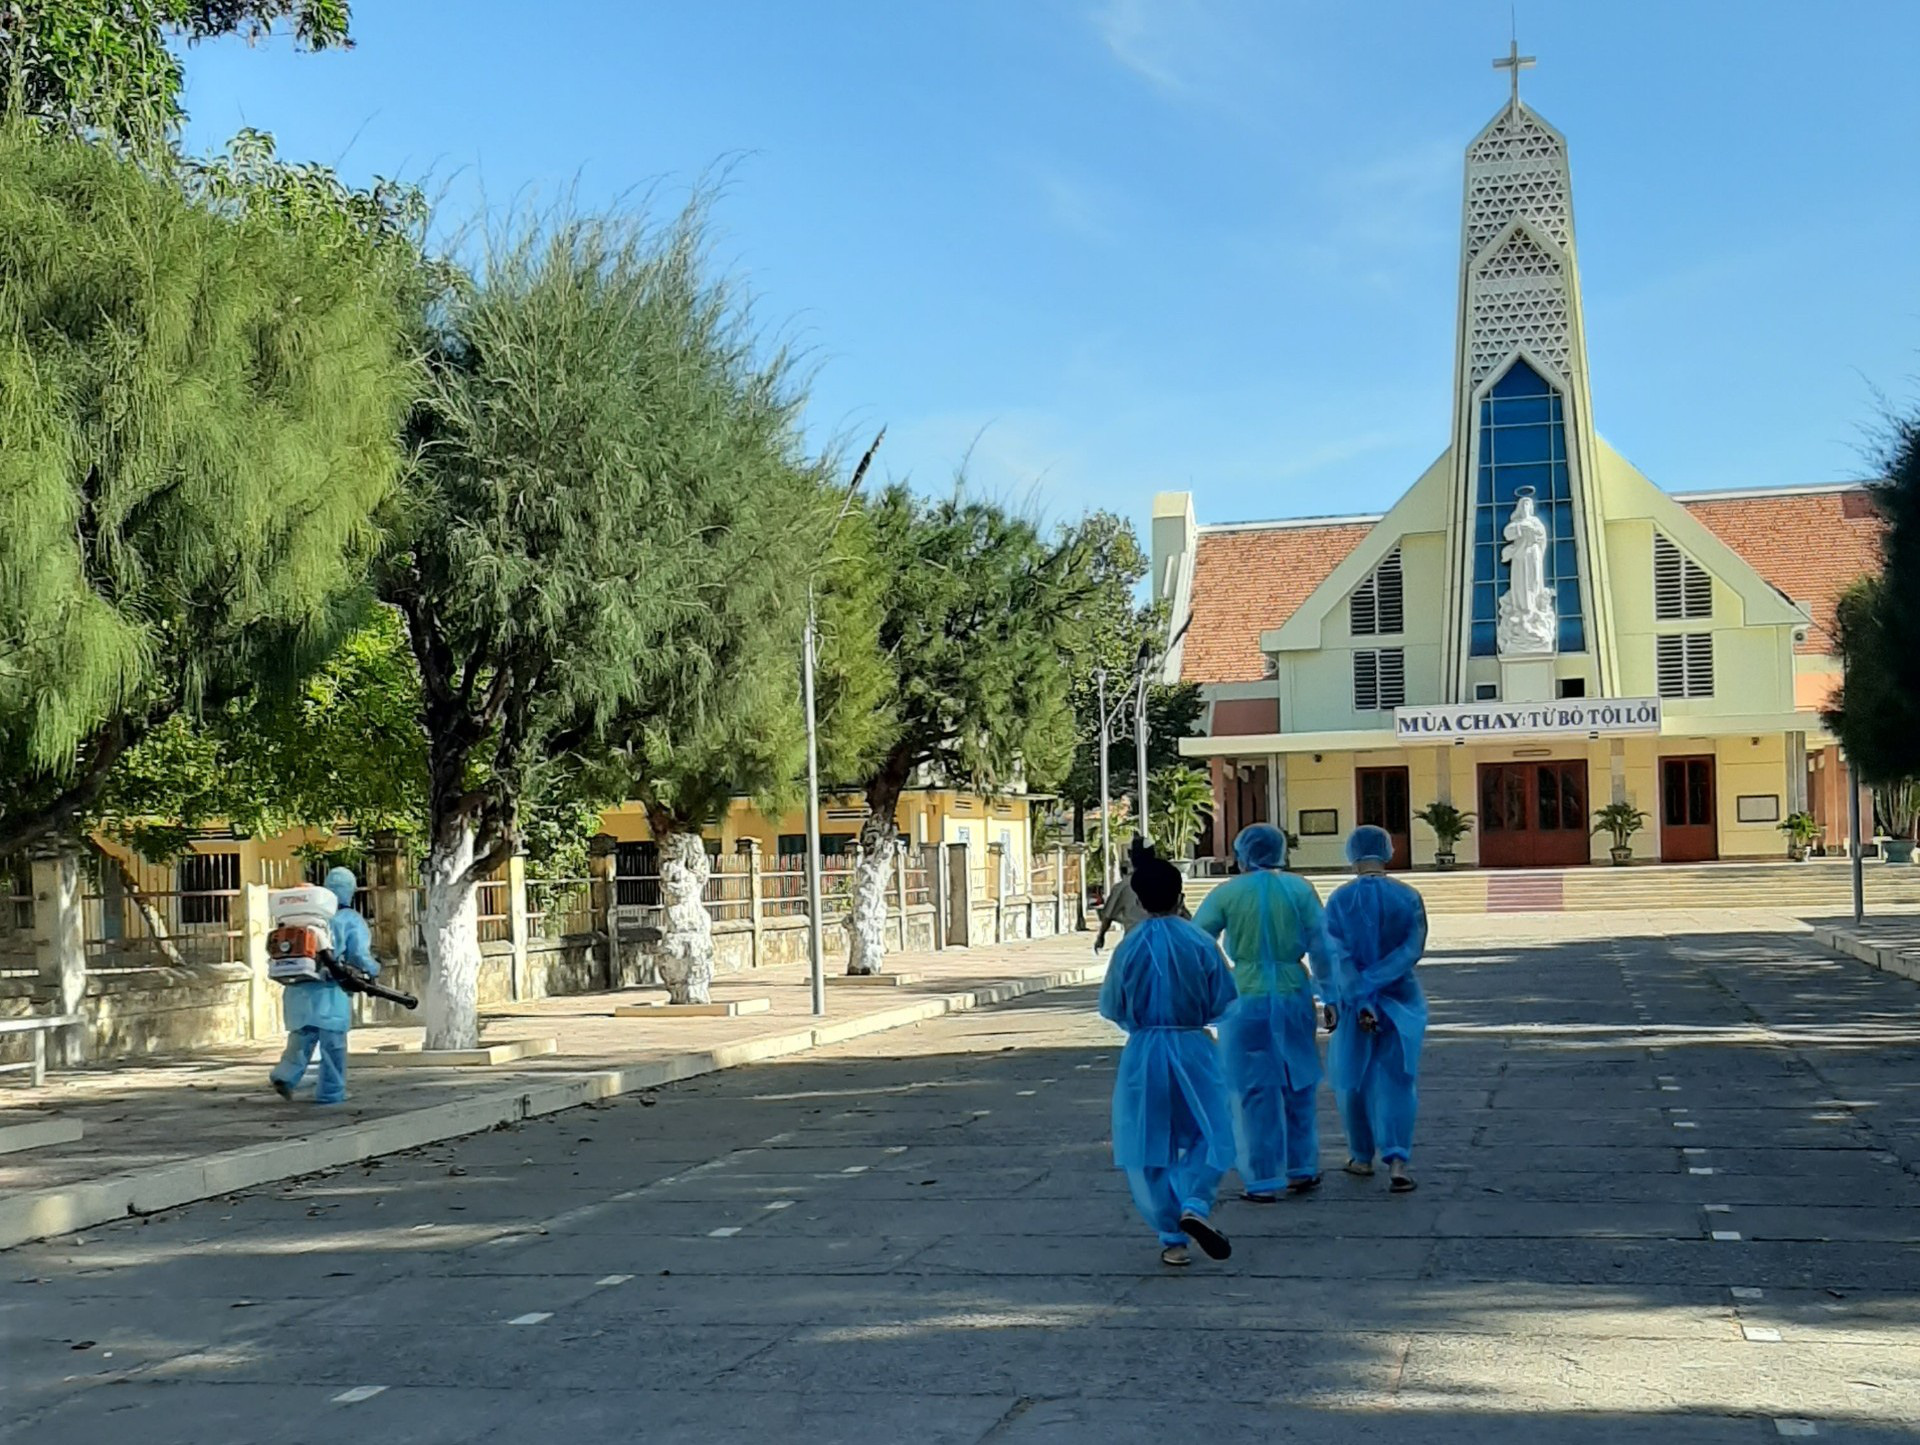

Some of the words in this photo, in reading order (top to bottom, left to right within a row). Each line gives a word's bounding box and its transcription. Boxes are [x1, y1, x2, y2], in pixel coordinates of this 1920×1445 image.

[1398, 712, 1452, 733] MÙA
[1528, 707, 1556, 727] TỪ
[1557, 705, 1584, 726] BỎ
[1587, 705, 1621, 727] TỘI
[1625, 701, 1657, 724] LỖI
